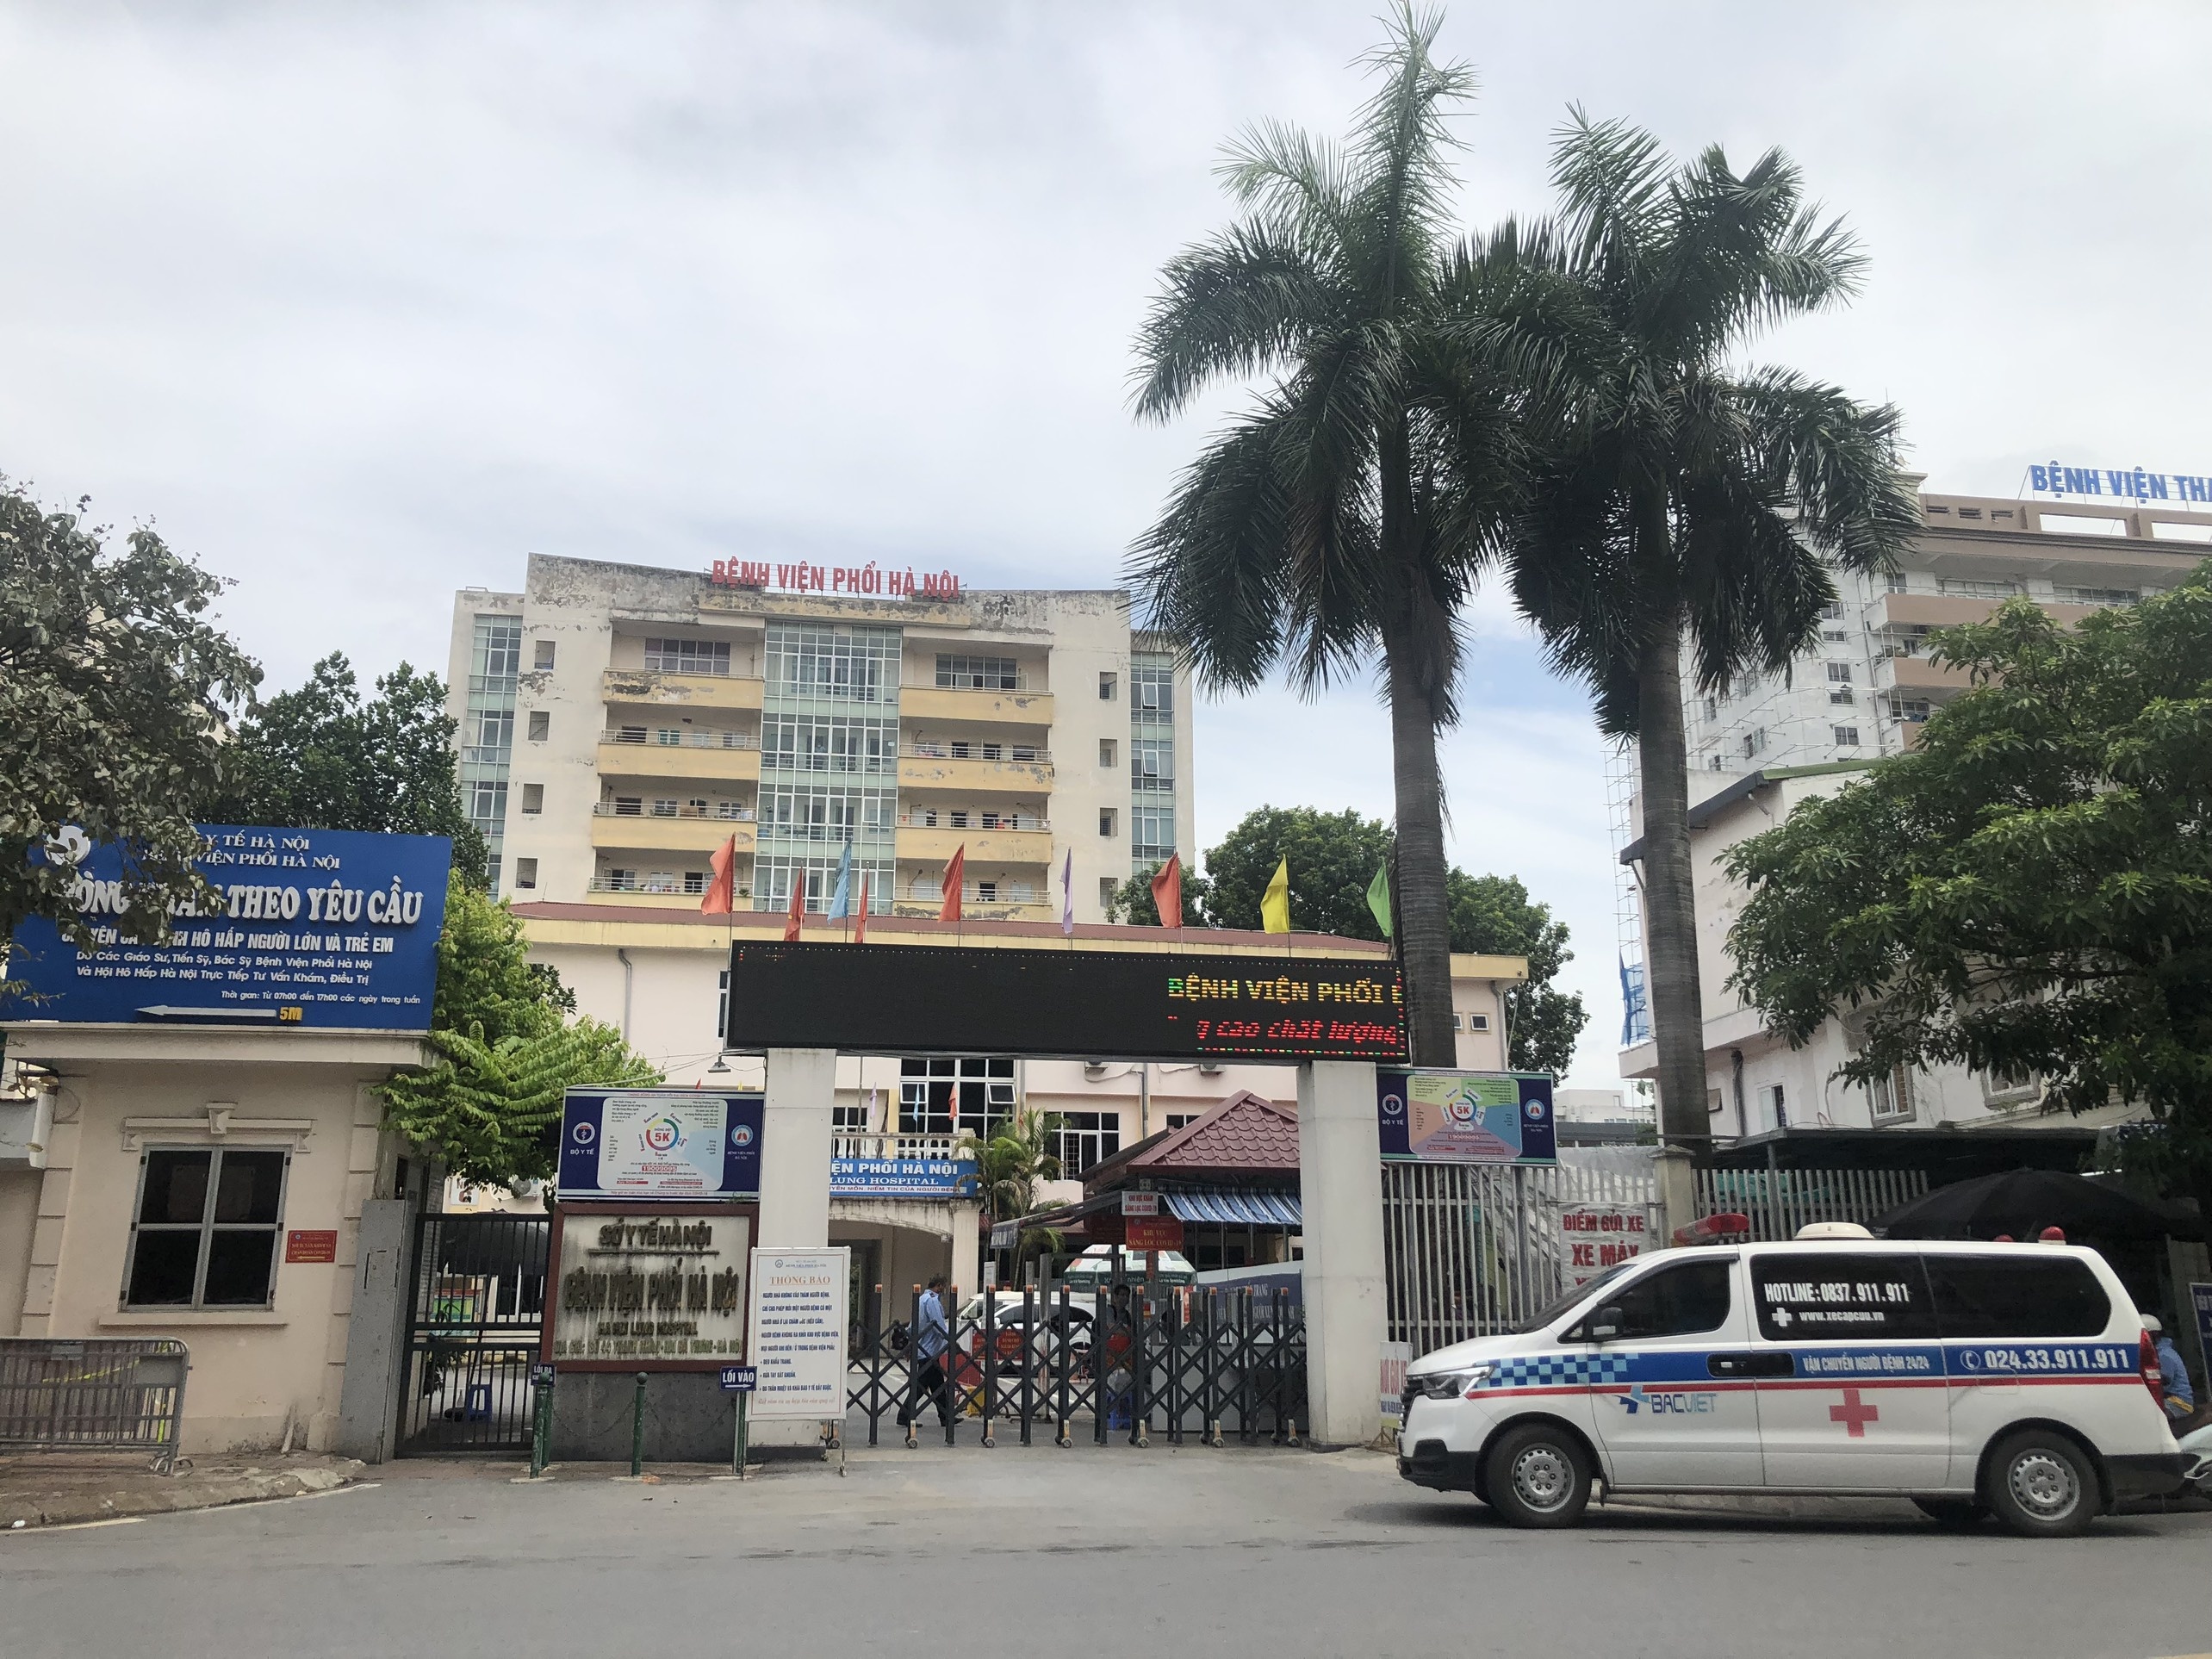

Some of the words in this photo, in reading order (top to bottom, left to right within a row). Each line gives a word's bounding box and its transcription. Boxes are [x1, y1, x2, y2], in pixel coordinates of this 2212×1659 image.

[2030, 460, 2101, 498] BỆNH
[2106, 466, 2168, 504] VIỆN
[711, 556, 770, 588] BỆNH
[777, 560, 824, 594] VIỆN
[832, 560, 881, 594] PHỔI
[888, 565, 916, 596] HÀ
[923, 569, 960, 602] NỘI
[205, 834, 216, 847] Y
[222, 830, 245, 847] TẾ
[251, 834, 276, 849] HÀ
[281, 835, 310, 852] NỘI
[239, 848, 277, 867] PHỔI
[282, 854, 308, 868] HÀ
[312, 854, 340, 871] NỘI
[227, 885, 301, 920] THEO
[307, 879, 363, 923] YÊU
[367, 874, 424, 924] CẦU
[191, 929, 212, 947] HÔ
[215, 926, 244, 948] HẤP
[247, 930, 290, 950] NGƯỜI
[294, 932, 321, 951] LỚN
[325, 933, 341, 952] VÀ
[345, 932, 369, 952] TRẺ
[372, 937, 394, 953] EM
[96, 949, 120, 961] Các
[124, 951, 151, 962] Giáo
[172, 951, 193, 963] Tiến
[214, 954, 235, 965] Bác
[239, 956, 252, 967] Sỹ
[256, 956, 282, 967] Bệnh
[286, 958, 308, 968] Viện
[312, 955, 334, 968] Phổi
[338, 958, 351, 969] Hà
[355, 959, 372, 970] Nội
[77, 966, 91, 976] Và
[95, 966, 113, 979] Hội
[115, 966, 131, 977] Hô
[134, 966, 157, 979] Hấp
[160, 966, 176, 978] Hà
[179, 969, 197, 980] Nội
[201, 970, 223, 980] Trực
[227, 968, 249, 982] Tiếp
[253, 971, 266, 980] Tư
[270, 969, 289, 982] Vấn
[294, 972, 327, 985] Khám,
[330, 972, 353, 984] Điều
[357, 975, 369, 986] Trị
[299, 992, 314, 1001] đến
[317, 993, 338, 1002] 17h00
[358, 996, 378, 1004] ngày
[381, 996, 401, 1004] trong
[1168, 972, 1238, 1001] BỆNH
[1246, 975, 1308, 1003] VIỆN
[1318, 978, 1383, 1003] PHỔI
[279, 1007, 302, 1021] 5M
[1457, 1105, 1469, 1115] 5K
[655, 1130, 670, 1141] 5K
[570, 1147, 580, 1156] BỘ
[858, 1159, 898, 1174] PHỔI
[902, 1161, 925, 1175] HÀ
[929, 1163, 958, 1177] NỘI
[869, 1177, 939, 1185] HOSPITAL
[1563, 1208, 1598, 1232] ĐIỂM
[1626, 1215, 1644, 1233] XE
[599, 1217, 624, 1246] SỞ
[625, 1224, 637, 1246] Y
[637, 1217, 658, 1246] TẾ
[659, 1218, 682, 1246] HÀ
[684, 1220, 712, 1249] NỘI
[1571, 1244, 1595, 1267] XE
[1600, 1240, 1639, 1267] MÁY
[563, 1265, 606, 1314] BỆNH
[609, 1265, 644, 1317] VIỆN
[648, 1257, 683, 1311] PHỔI
[687, 1265, 707, 1312] HÀ
[711, 1265, 739, 1317] NỘI
[770, 1275, 806, 1284] THÔNG
[810, 1273, 830, 1284] BÁO
[1799, 1310, 1885, 1321] www.xecapcuu.vn
[1803, 1355, 1821, 1373] VẬN
[1822, 1351, 1854, 1371] CHUYỂN
[1855, 1353, 1880, 1370] NGƯỜI
[1882, 1354, 1904, 1373] BỆNH
[1906, 1356, 1929, 1370] 24/24
[1984, 1349, 2129, 1369] 024.33.911.911
[722, 1368, 736, 1383] LỐI
[737, 1369, 755, 1383] VÀO
